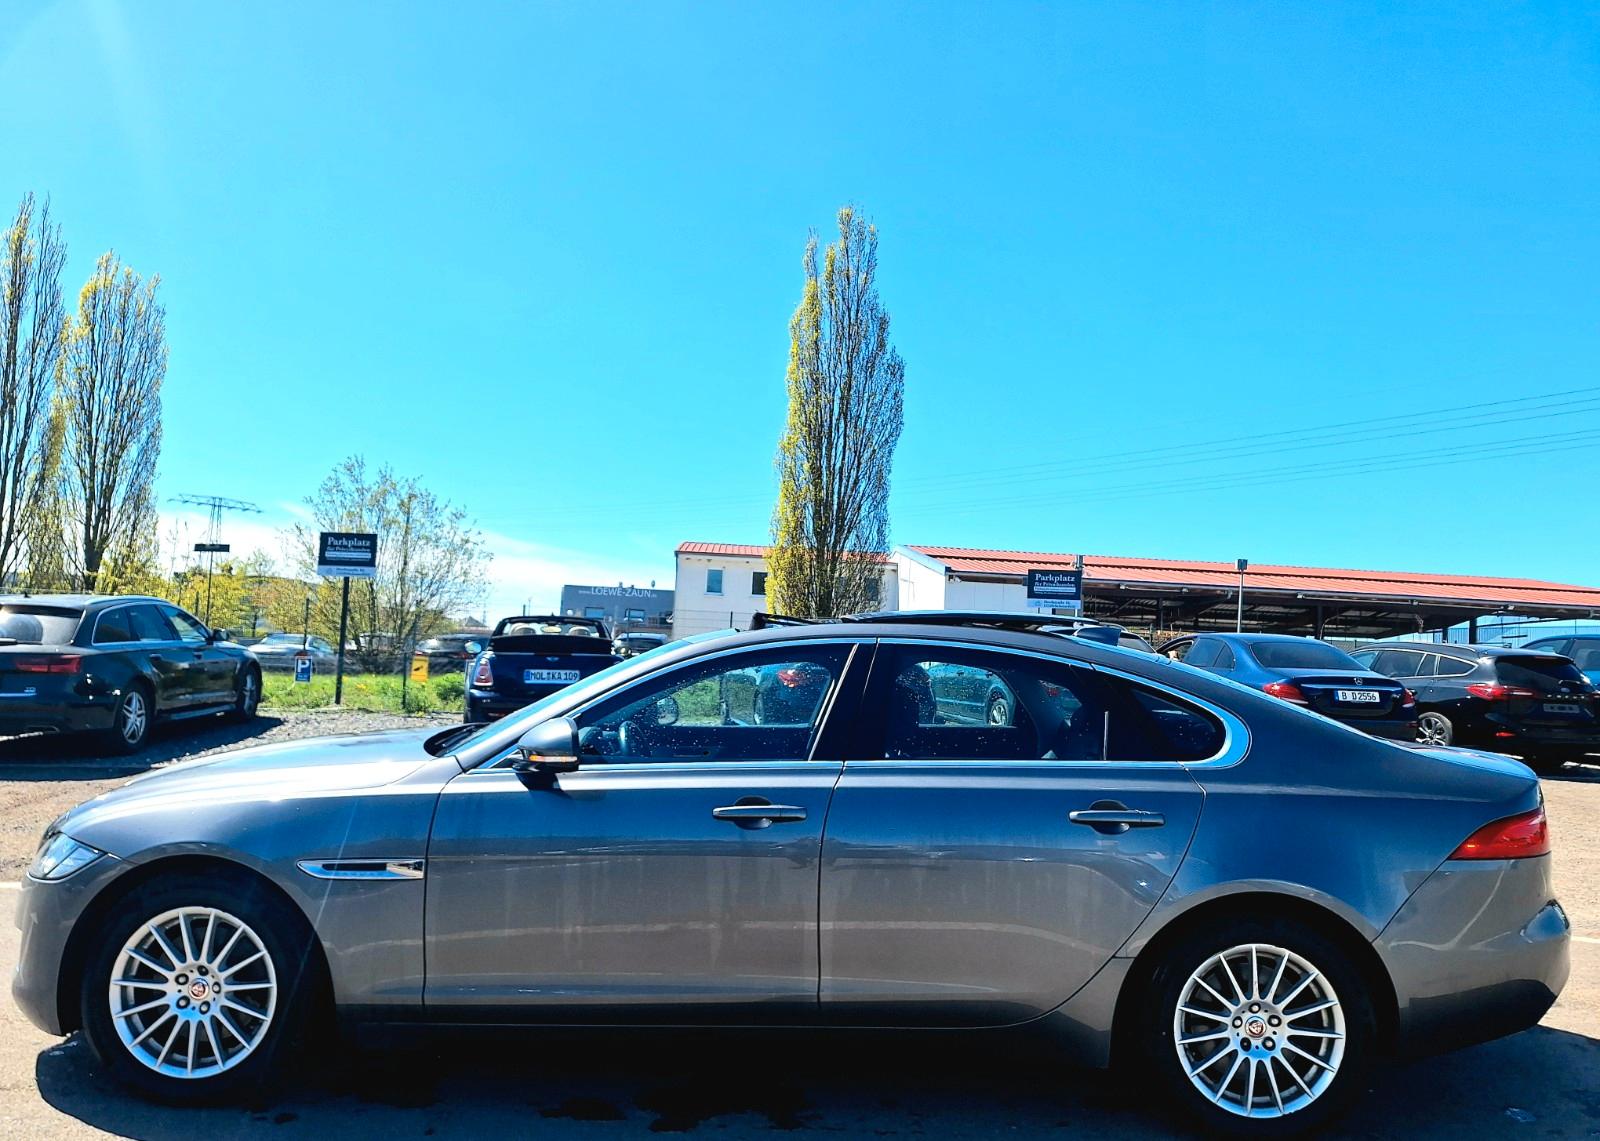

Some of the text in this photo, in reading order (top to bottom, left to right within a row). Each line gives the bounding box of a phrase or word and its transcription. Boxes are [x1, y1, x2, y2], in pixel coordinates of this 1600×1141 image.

[327, 536, 370, 547] Parkplatz
[1035, 573, 1076, 583] Parkplatz
[297, 659, 310, 673] P
[551, 671, 563, 681] KA
[1341, 691, 1348, 700] B
